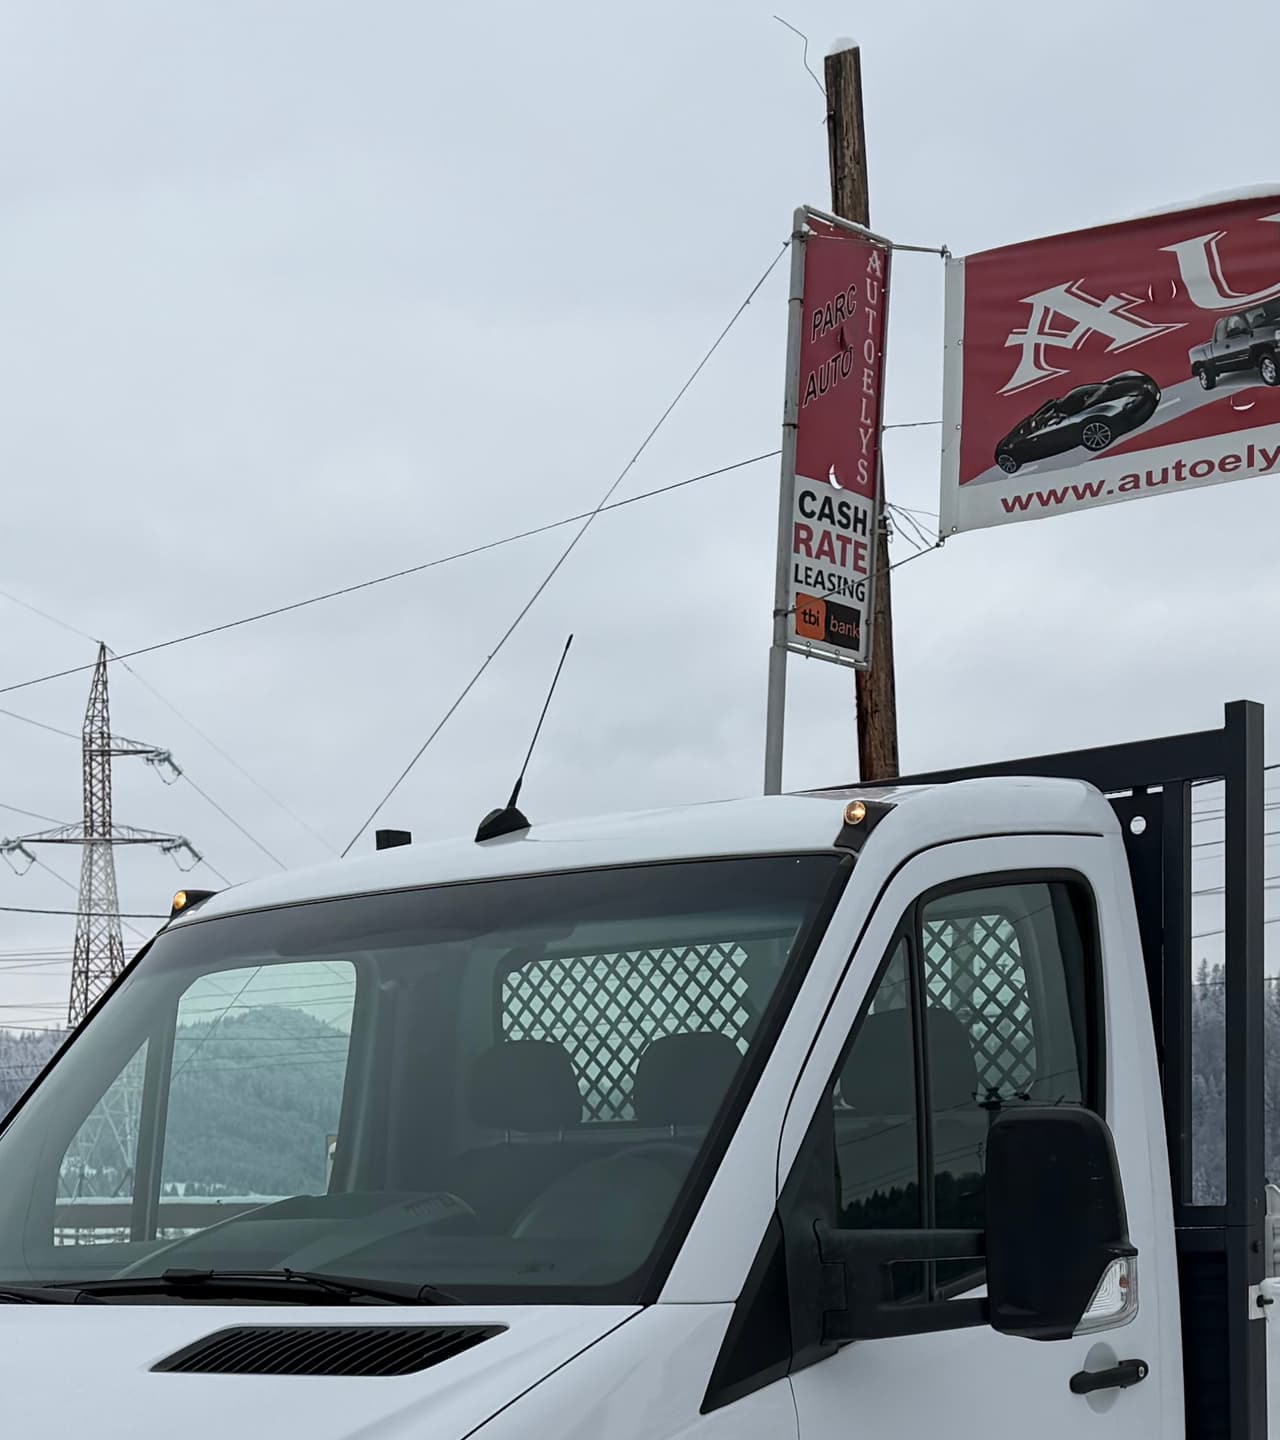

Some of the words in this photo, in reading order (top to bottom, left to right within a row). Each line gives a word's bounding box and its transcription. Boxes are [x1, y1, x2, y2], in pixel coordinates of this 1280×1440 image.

[811, 283, 857, 344] PARC
[802, 345, 854, 409] AUTO
[857, 249, 882, 486] AUTOELYS
[798, 490, 868, 537] CASH
[793, 521, 868, 575] RATE
[794, 563, 866, 602] LEASING
[801, 608, 820, 627] tbi
[830, 615, 860, 638] bank
